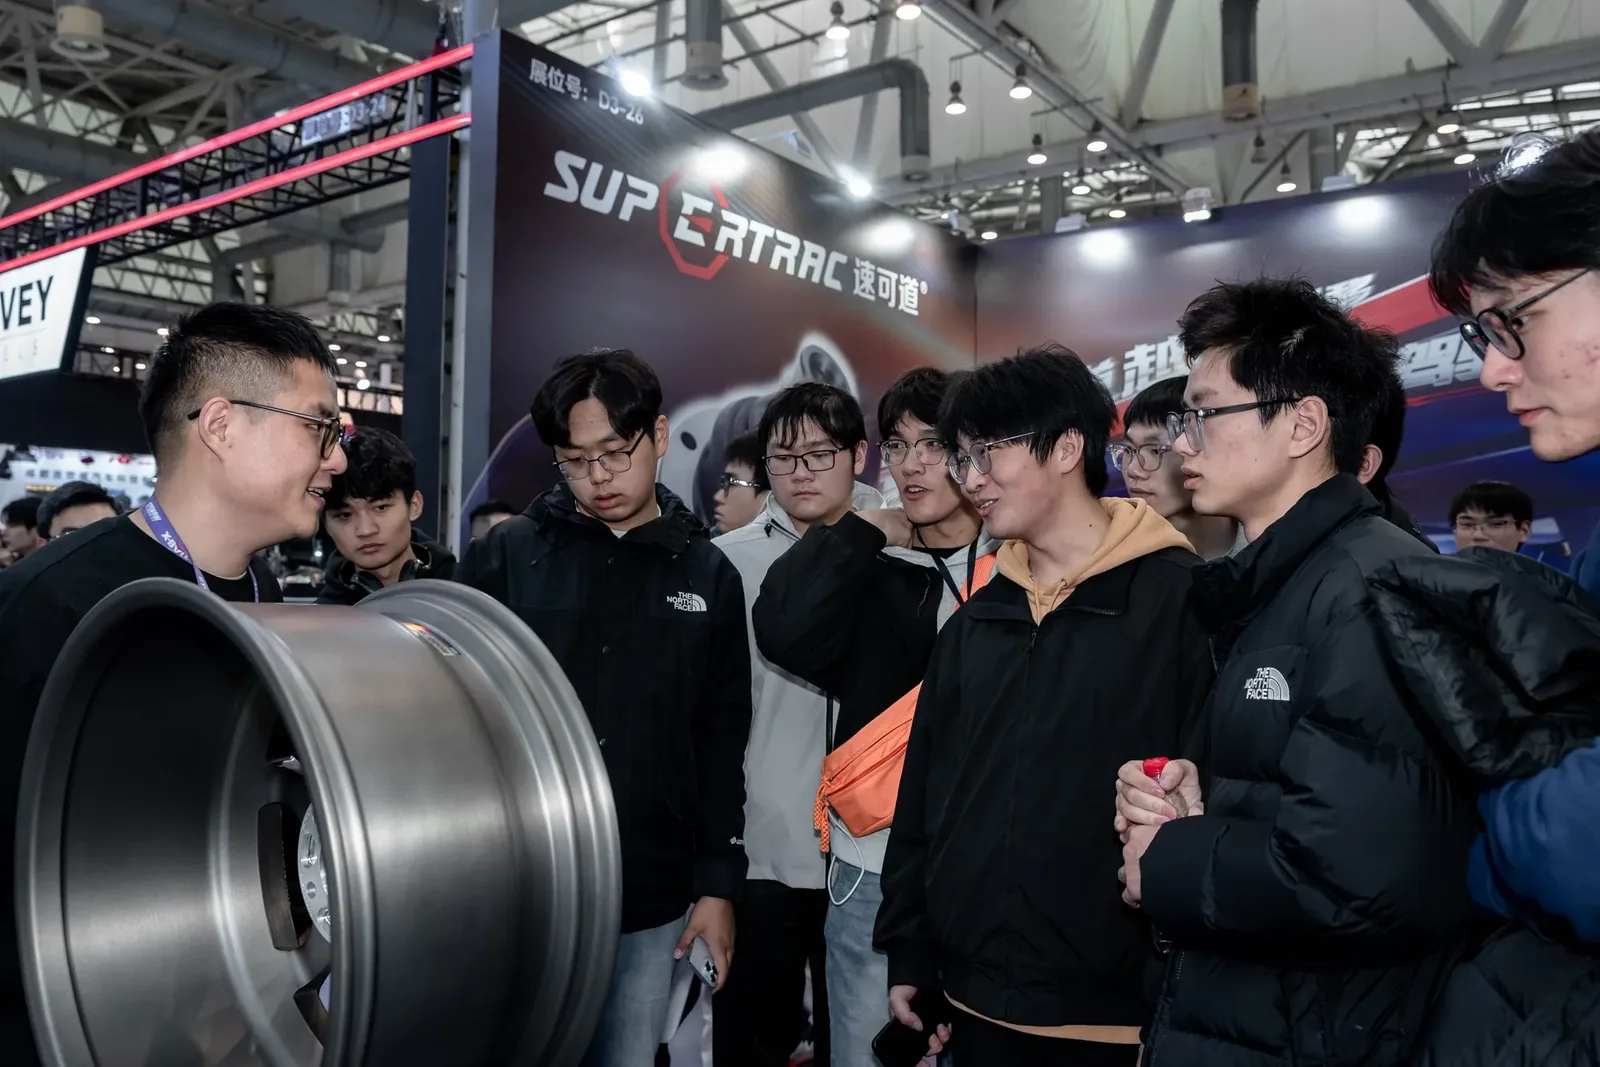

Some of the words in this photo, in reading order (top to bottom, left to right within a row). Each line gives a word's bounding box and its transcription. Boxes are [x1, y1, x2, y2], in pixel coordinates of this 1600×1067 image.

[598, 90, 644, 125] D3-26
[853, 256, 919, 316] 速可道
[0, 275, 54, 331] VEY
[666, 595, 693, 606] NORTH
[677, 591, 693, 600] THE
[674, 602, 693, 612] FACE
[1255, 667, 1270, 678] THE
[1246, 688, 1268, 700] FACE
